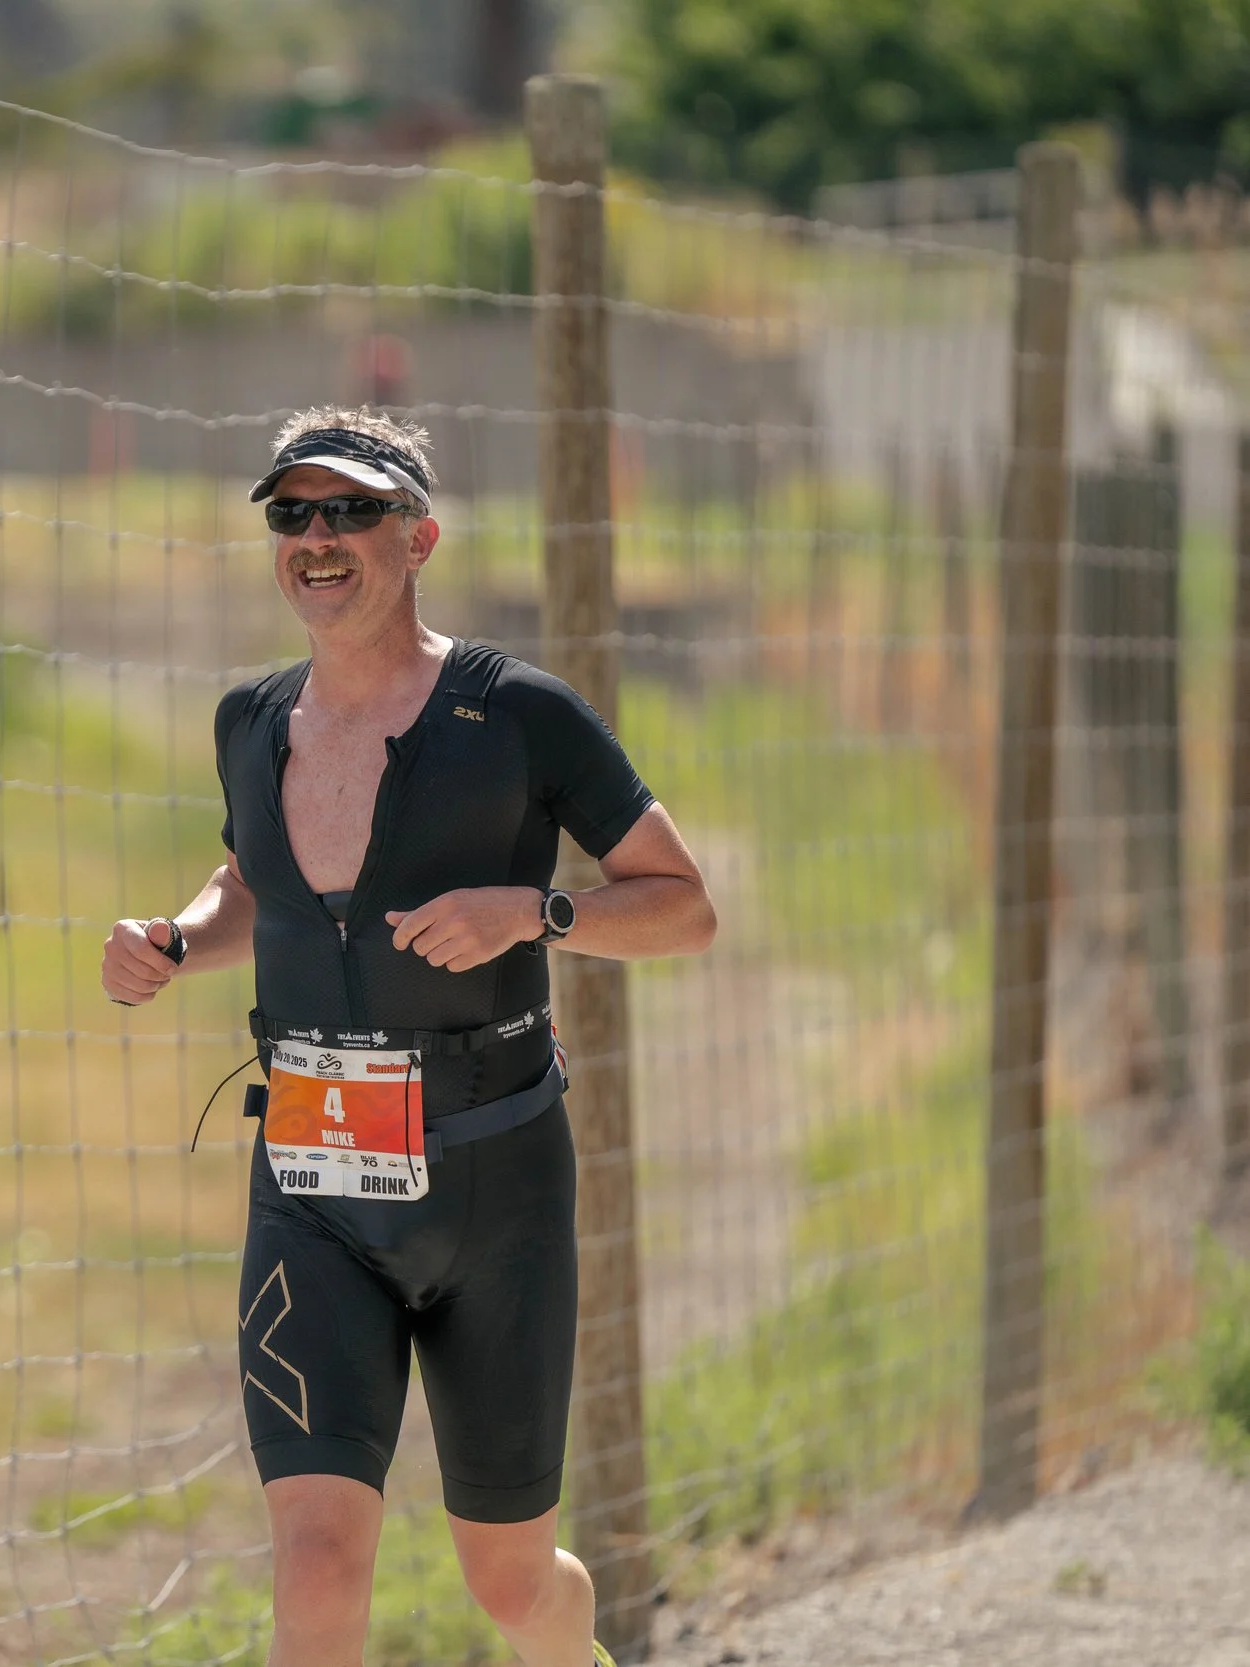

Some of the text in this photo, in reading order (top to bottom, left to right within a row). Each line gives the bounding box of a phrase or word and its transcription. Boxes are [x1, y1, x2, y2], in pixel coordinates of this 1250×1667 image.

[291, 1054, 308, 1068] 2025
[323, 1087, 346, 1124] 4
[321, 1129, 356, 1148] MIKE
[279, 1169, 320, 1189] FOOD
[361, 1174, 410, 1196] DRINK
